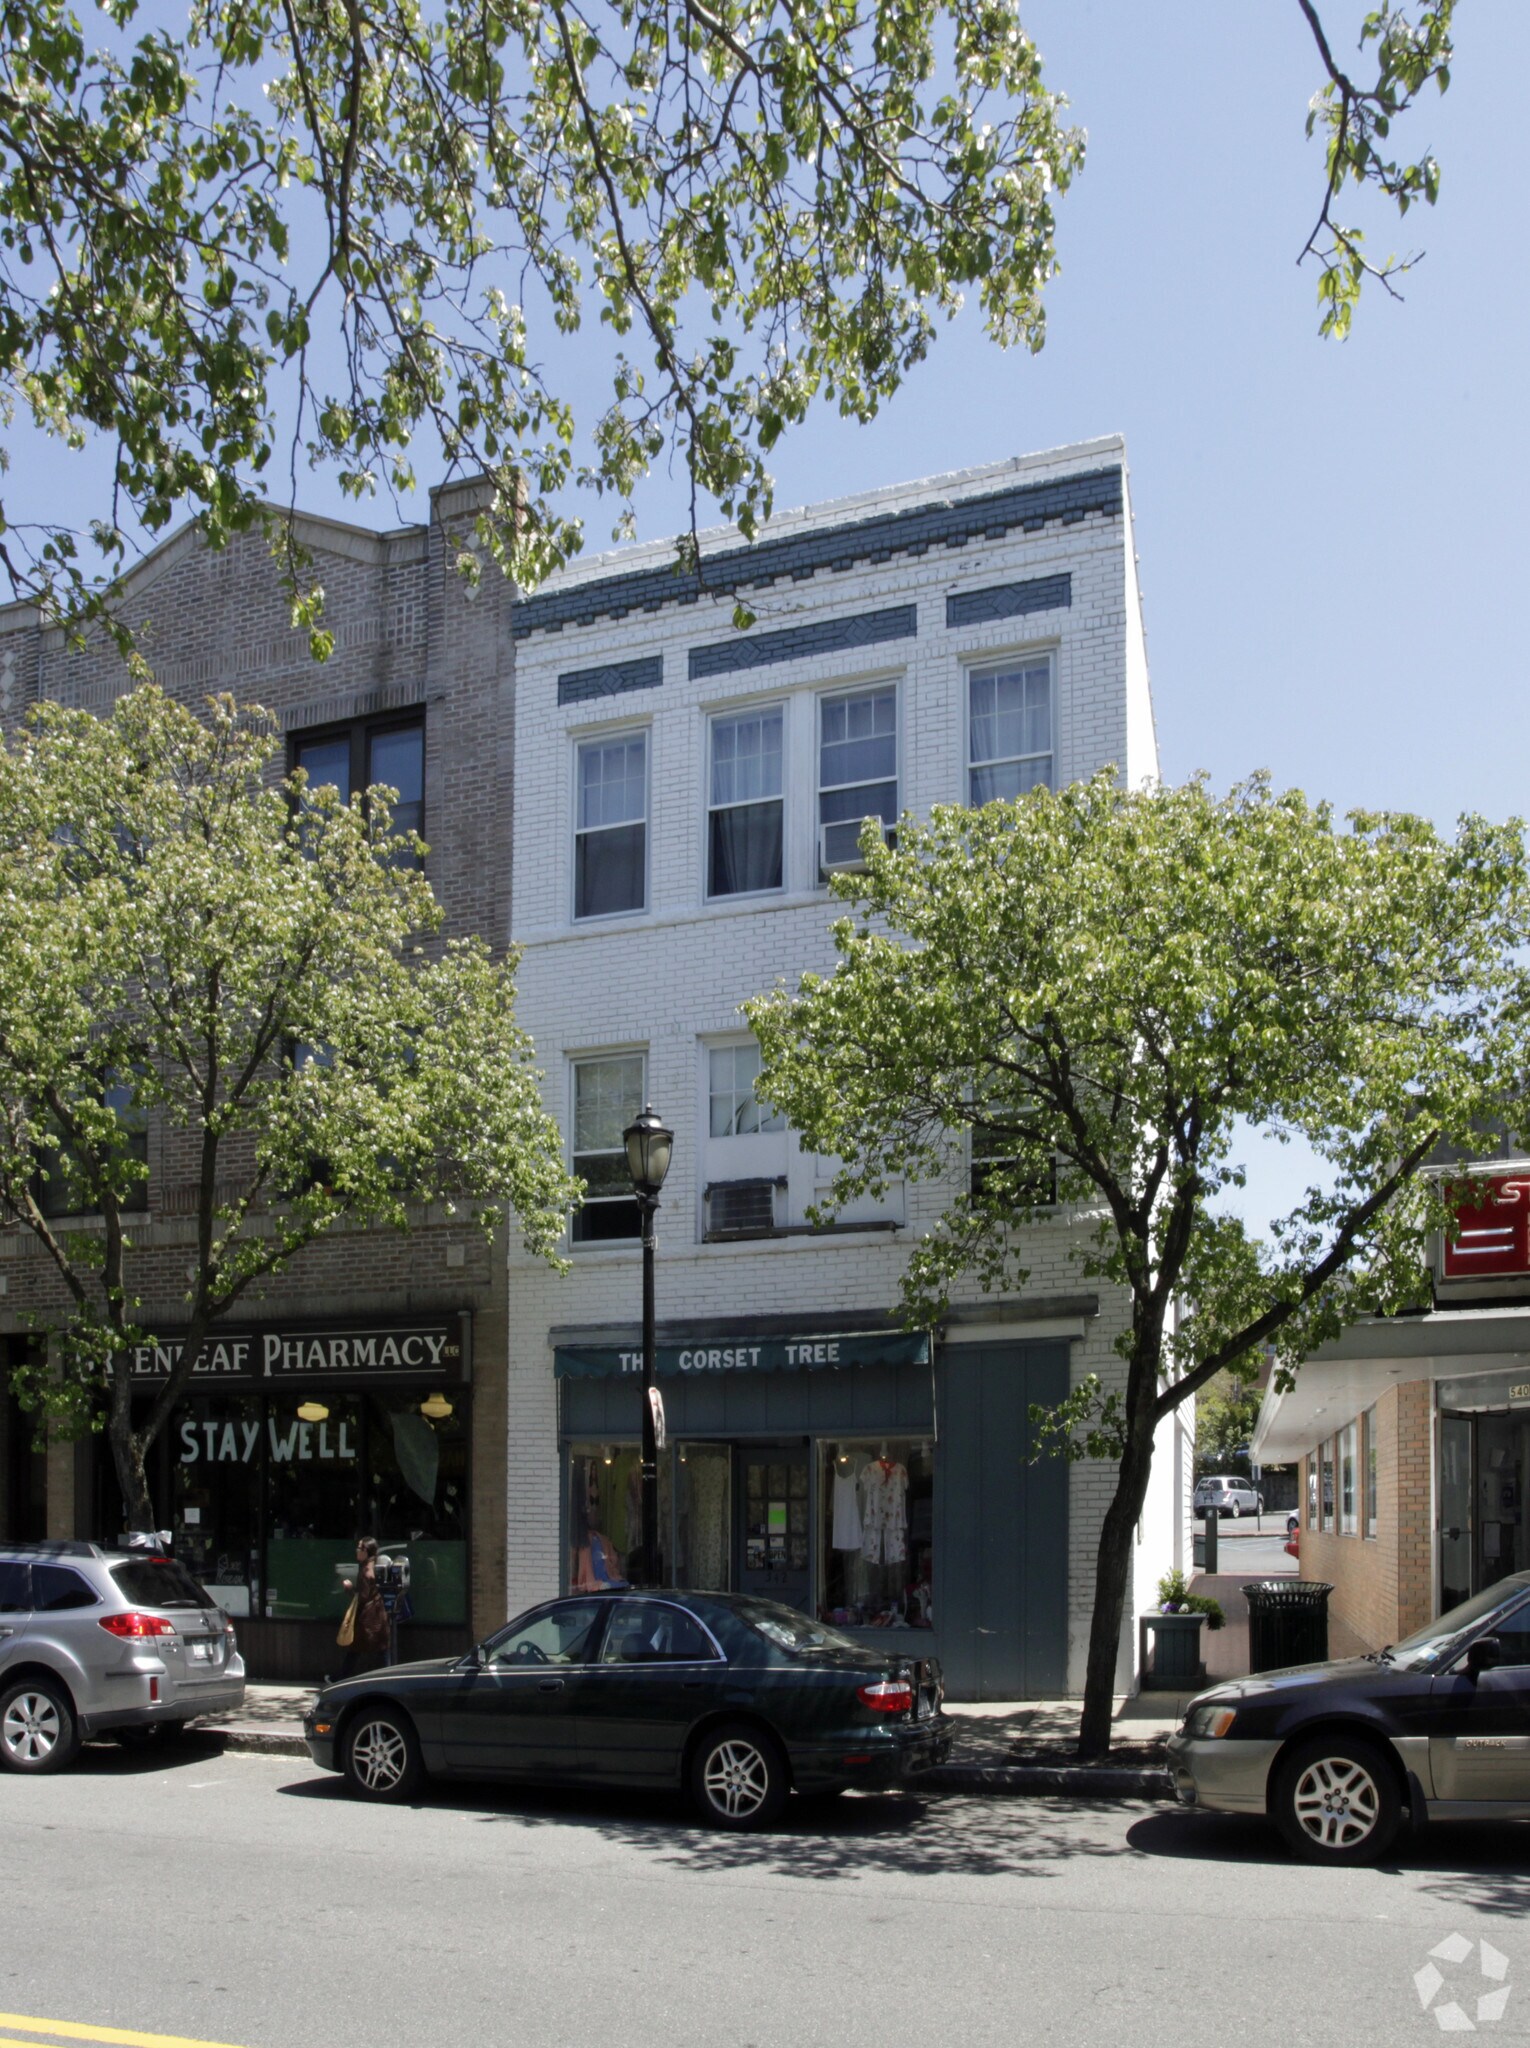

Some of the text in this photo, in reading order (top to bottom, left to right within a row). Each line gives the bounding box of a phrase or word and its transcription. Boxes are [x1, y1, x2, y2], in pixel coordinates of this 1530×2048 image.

[76, 1343, 250, 1382] RENEAF
[263, 1334, 447, 1377] PHARMACY
[619, 1343, 840, 1372] TH CORSET TREE
[180, 1417, 356, 1463] STAY WELL
